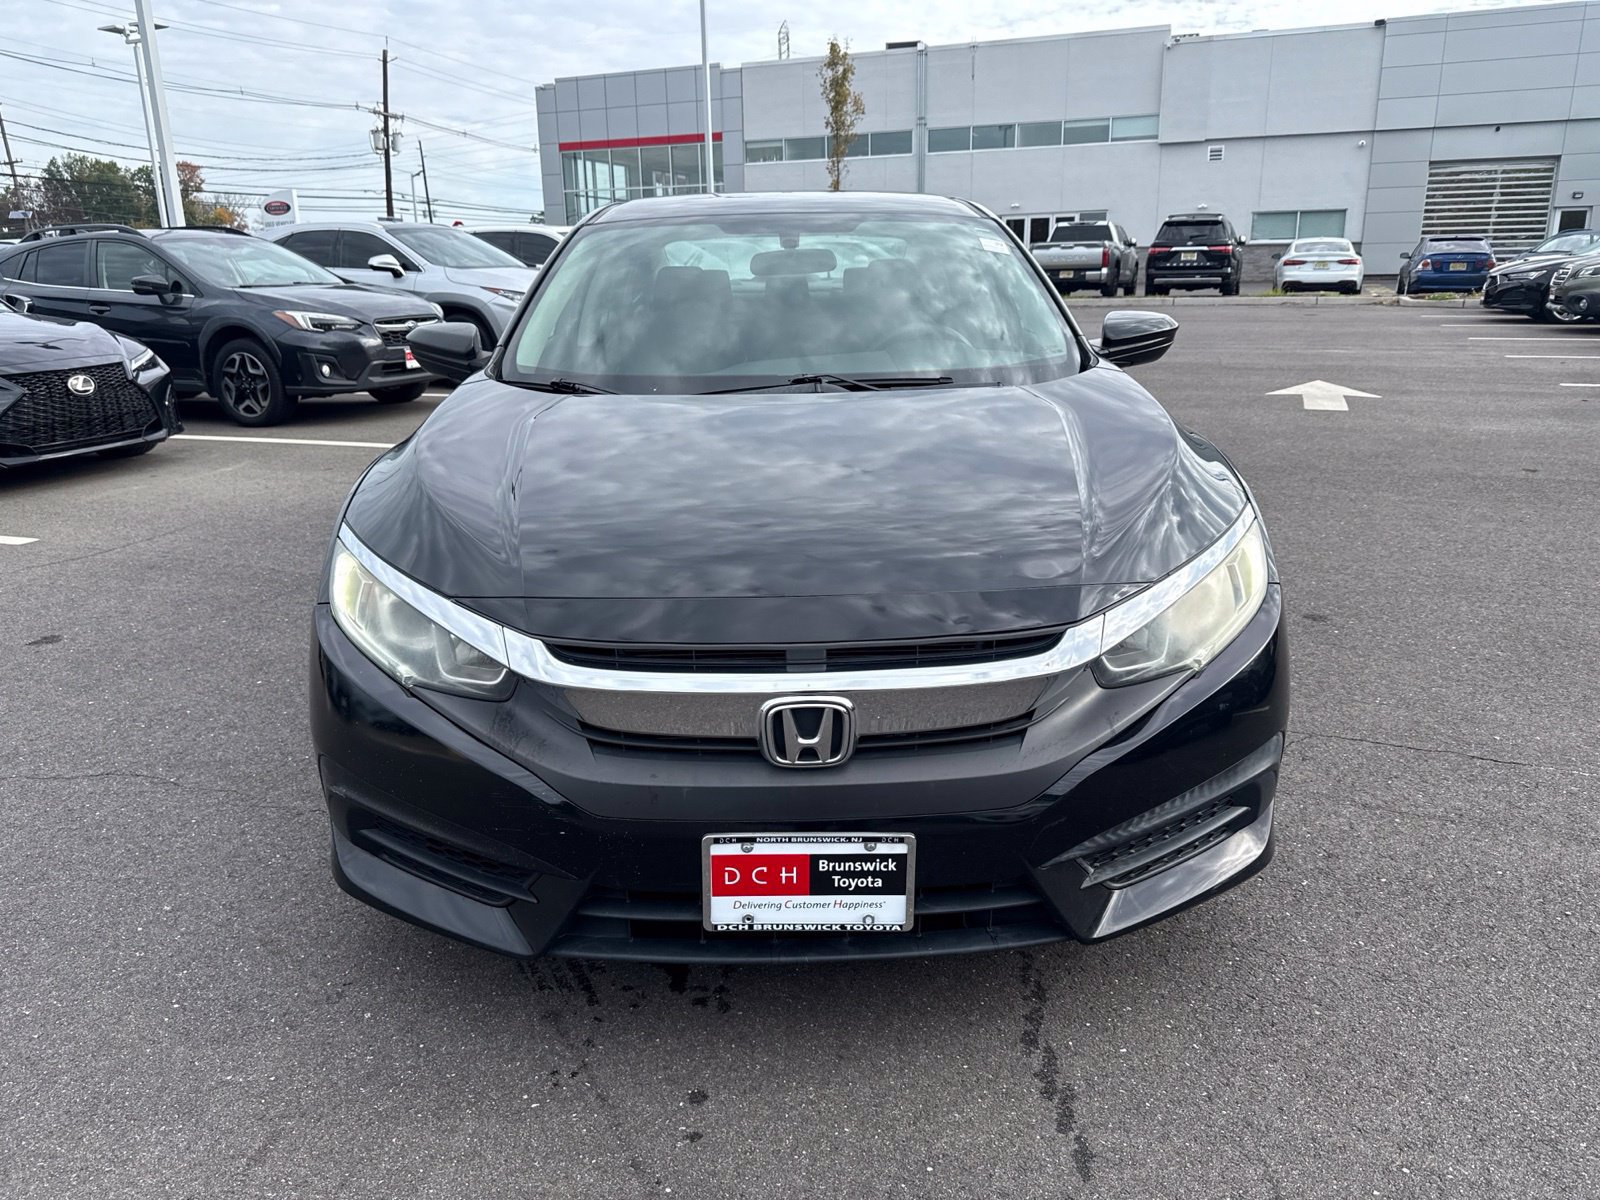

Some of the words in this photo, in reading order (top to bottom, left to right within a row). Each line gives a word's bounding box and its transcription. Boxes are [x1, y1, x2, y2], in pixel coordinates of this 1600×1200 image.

[818, 858, 897, 872] Brunswick
[832, 875, 883, 891] Toyota
[733, 900, 782, 911] Delivering
[784, 900, 831, 909] Customer
